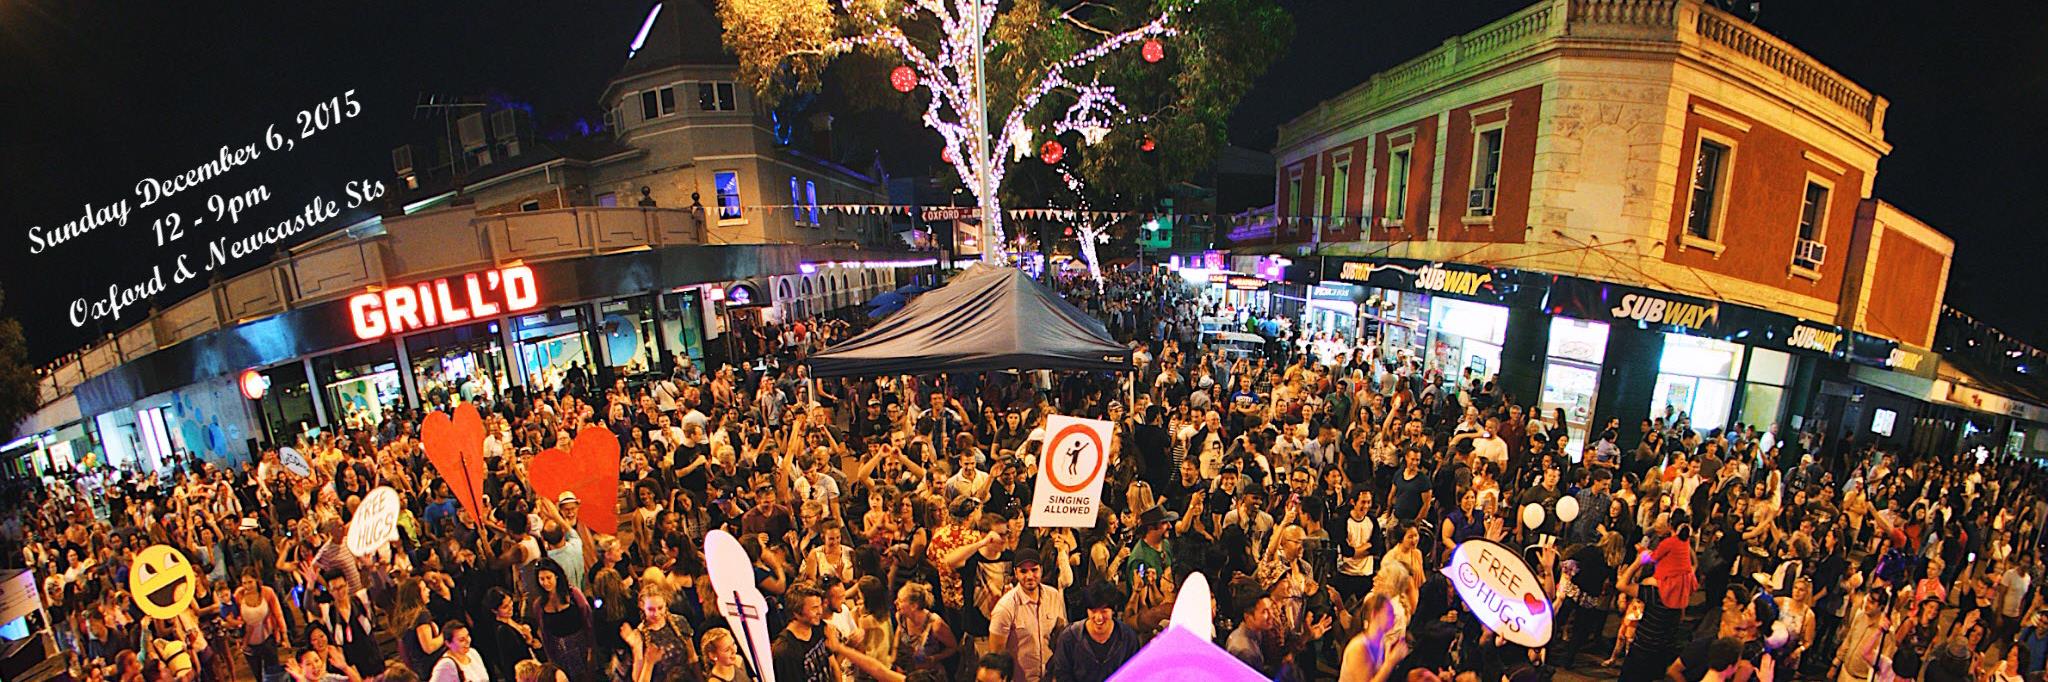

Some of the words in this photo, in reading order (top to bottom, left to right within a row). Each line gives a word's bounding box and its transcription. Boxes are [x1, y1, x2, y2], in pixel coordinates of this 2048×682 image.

[927, 209, 960, 221] OXFORD
[1340, 261, 1375, 281] SUBWAY
[1415, 264, 1491, 296] SUBWAY
[348, 265, 538, 341] GRILL'D
[1611, 293, 1718, 331] SUBWAY
[1787, 324, 1843, 353] SUBWAY
[1887, 346, 1924, 371] SUBWAY
[358, 489, 386, 526] FREE
[1043, 504, 1091, 515] ALLOWED
[1048, 495, 1091, 506] SINGING
[357, 511, 395, 549] HUGS
[1478, 547, 1523, 597] FREE
[1476, 581, 1527, 634] HUGS
